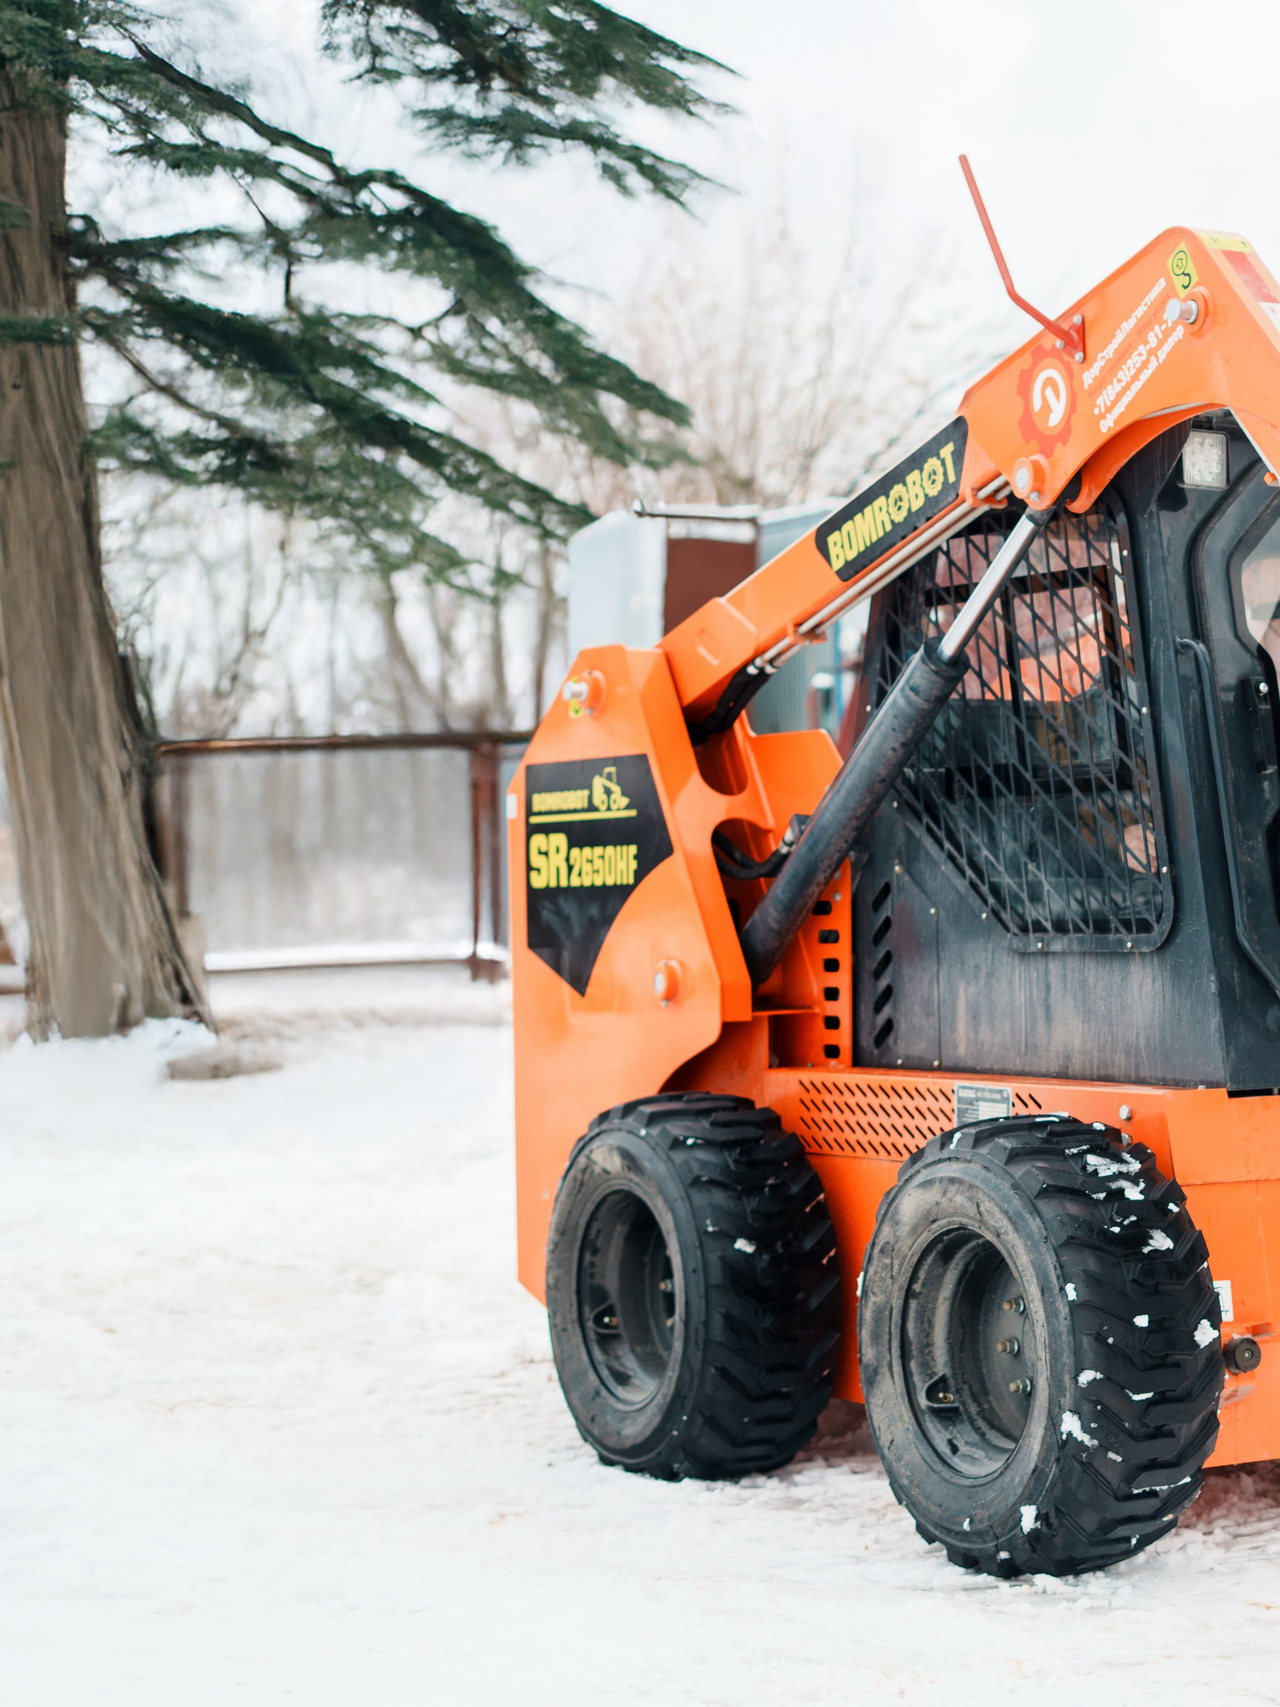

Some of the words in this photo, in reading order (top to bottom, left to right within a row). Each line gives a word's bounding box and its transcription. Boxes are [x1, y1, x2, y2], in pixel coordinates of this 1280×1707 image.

[1082, 277, 1166, 389] ДорСтройЛогистика
[1099, 355, 1159, 434] Официальный
[1156, 324, 1184, 365] дилер
[1137, 316, 1152, 338] Ваш
[827, 441, 956, 572] BOMROBOT
